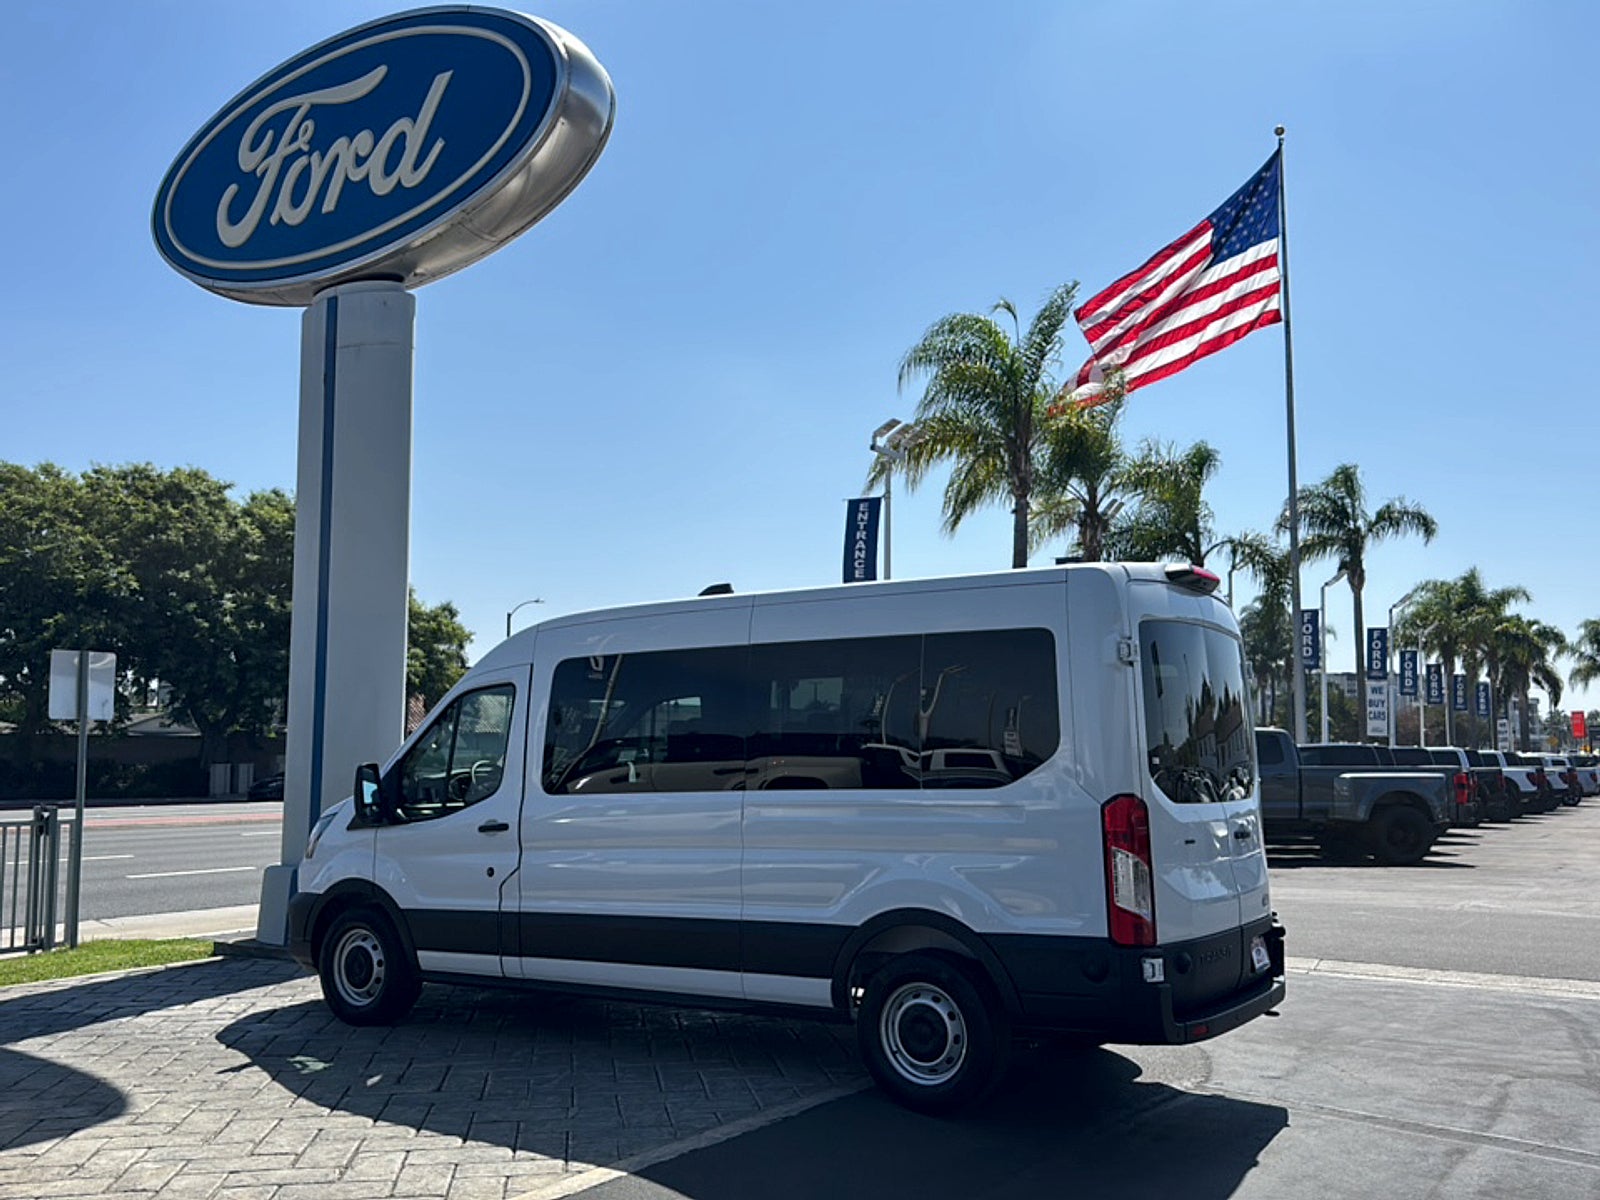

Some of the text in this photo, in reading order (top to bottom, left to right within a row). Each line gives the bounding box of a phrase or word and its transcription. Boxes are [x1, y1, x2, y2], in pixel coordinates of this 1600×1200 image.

[216, 64, 454, 249] Ford
[854, 502, 869, 578] ENTRANCE
[1302, 612, 1313, 657] FORD
[1371, 630, 1382, 670] FORD
[1404, 652, 1413, 686] FORD
[1430, 667, 1439, 696] FORD
[1368, 699, 1385, 708] BUY
[1370, 686, 1384, 695] WE
[1368, 710, 1386, 720] CARS
